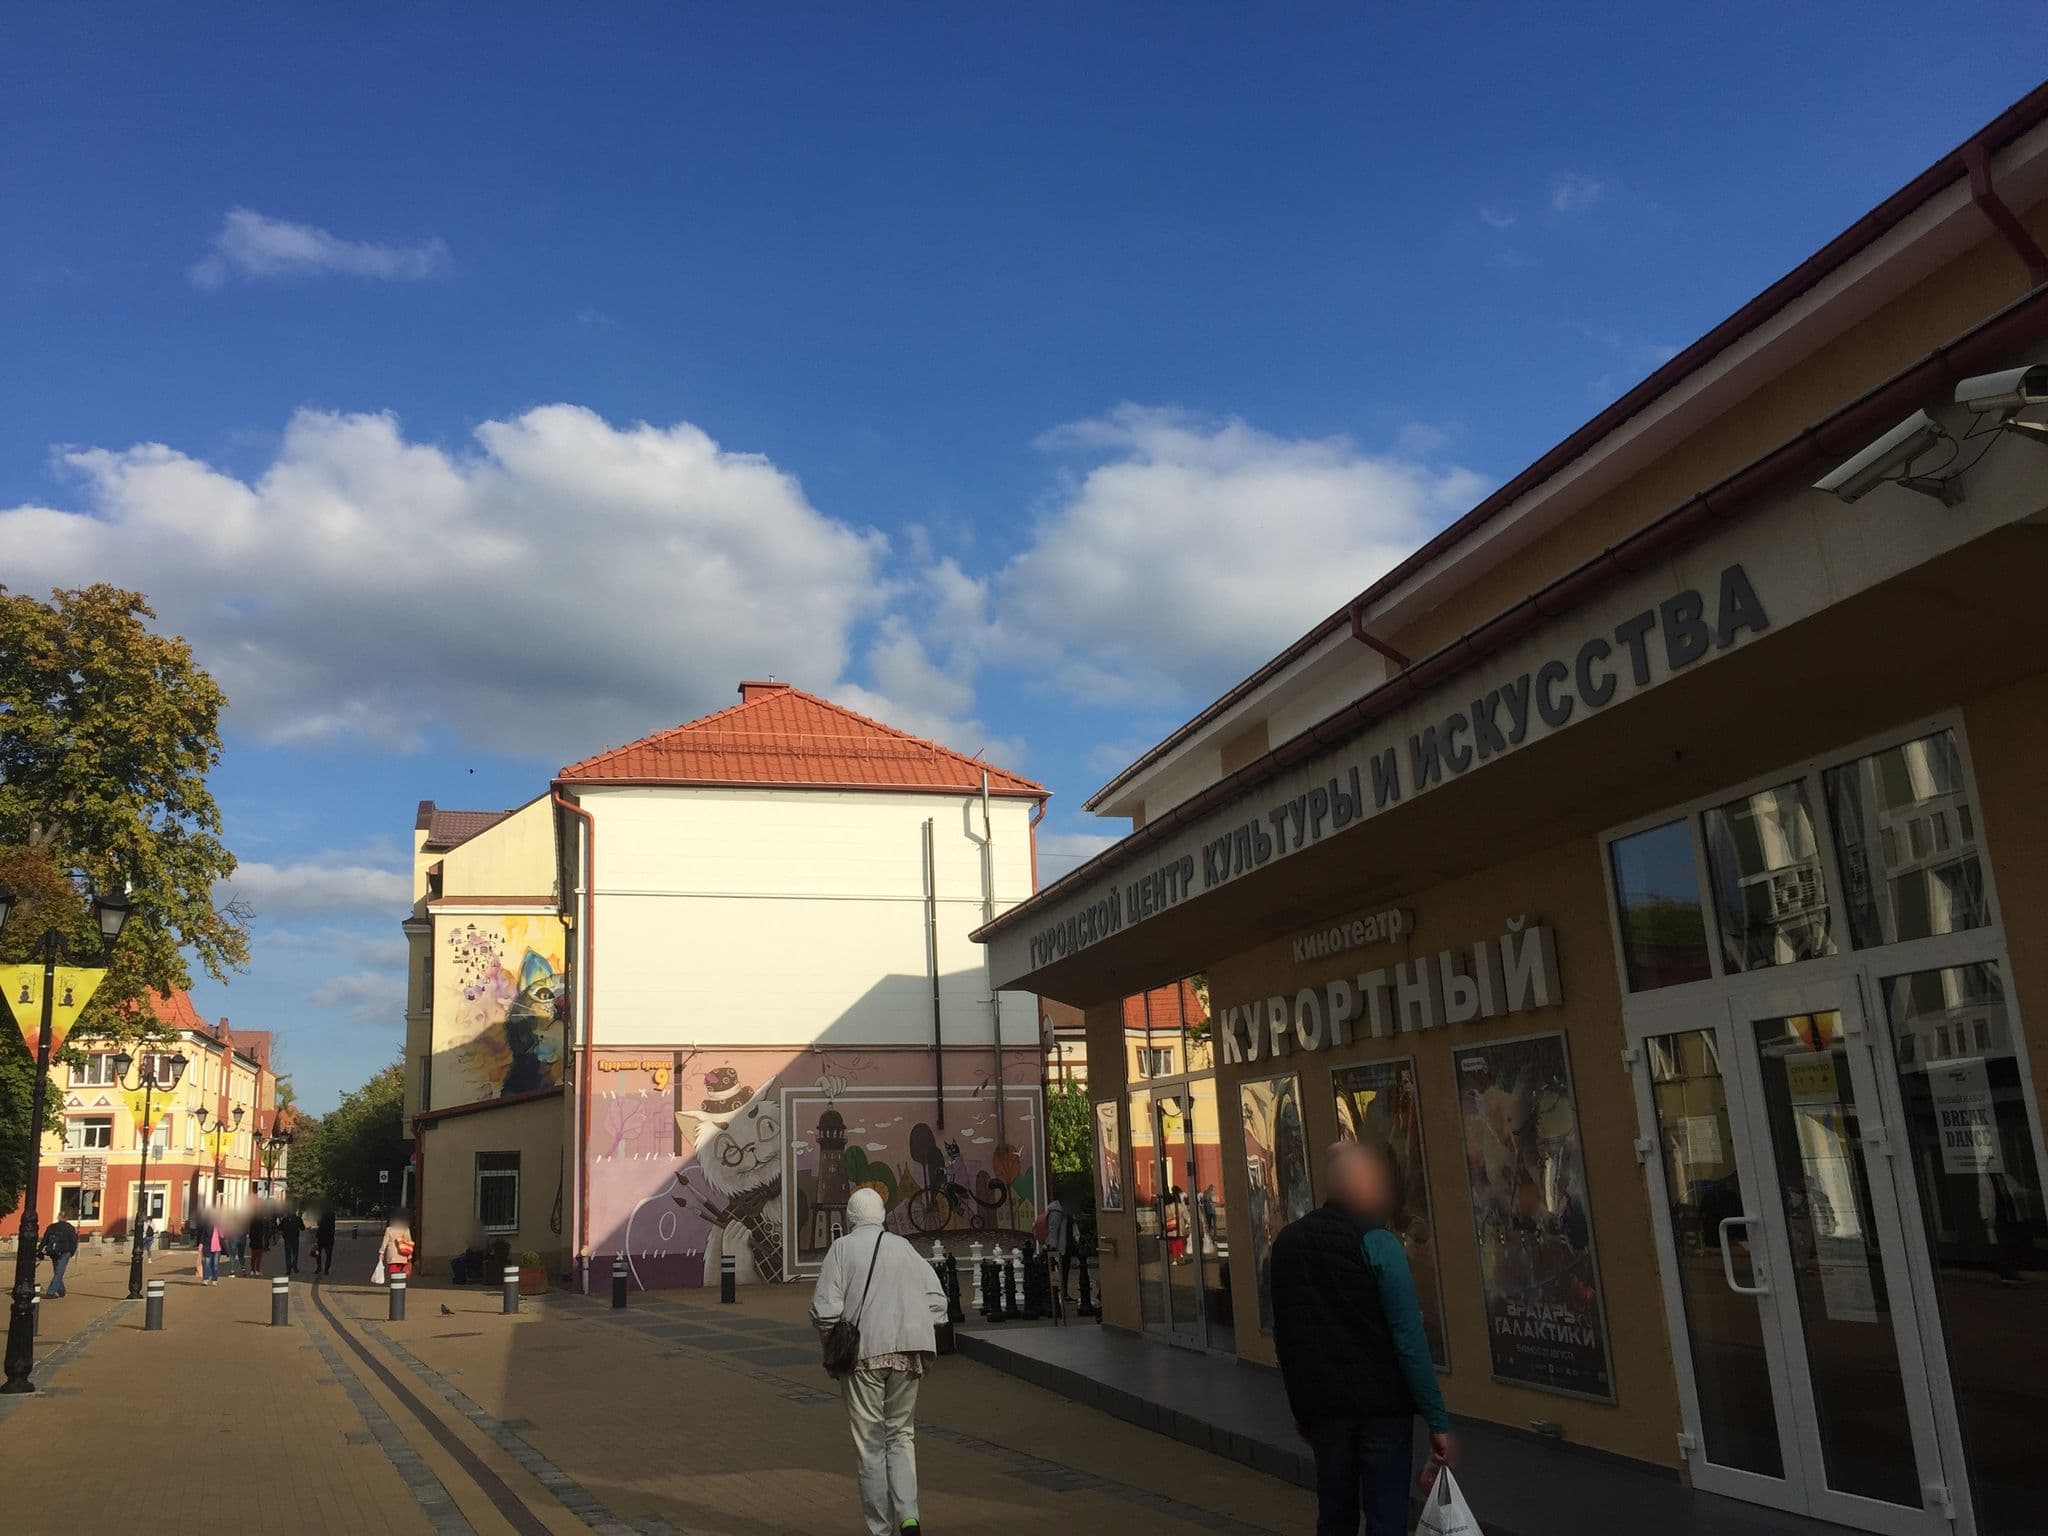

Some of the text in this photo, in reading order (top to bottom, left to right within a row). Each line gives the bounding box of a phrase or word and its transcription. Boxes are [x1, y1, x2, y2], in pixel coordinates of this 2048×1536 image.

[1029, 564, 1771, 970] ГОРОДСКОЙ ЦЕНТР КУЛЬТУРЫ И ИСКУССТВА
[1292, 907, 1407, 963] кинотеатр
[1220, 914, 1555, 1065] КУРОРТНЫЙ
[653, 1068, 669, 1091] 9
[1942, 1109, 1989, 1127] BREAK
[1945, 1130, 1992, 1148] DANCE
[1494, 1315, 1597, 1350] ГАЛАКТИКИ
